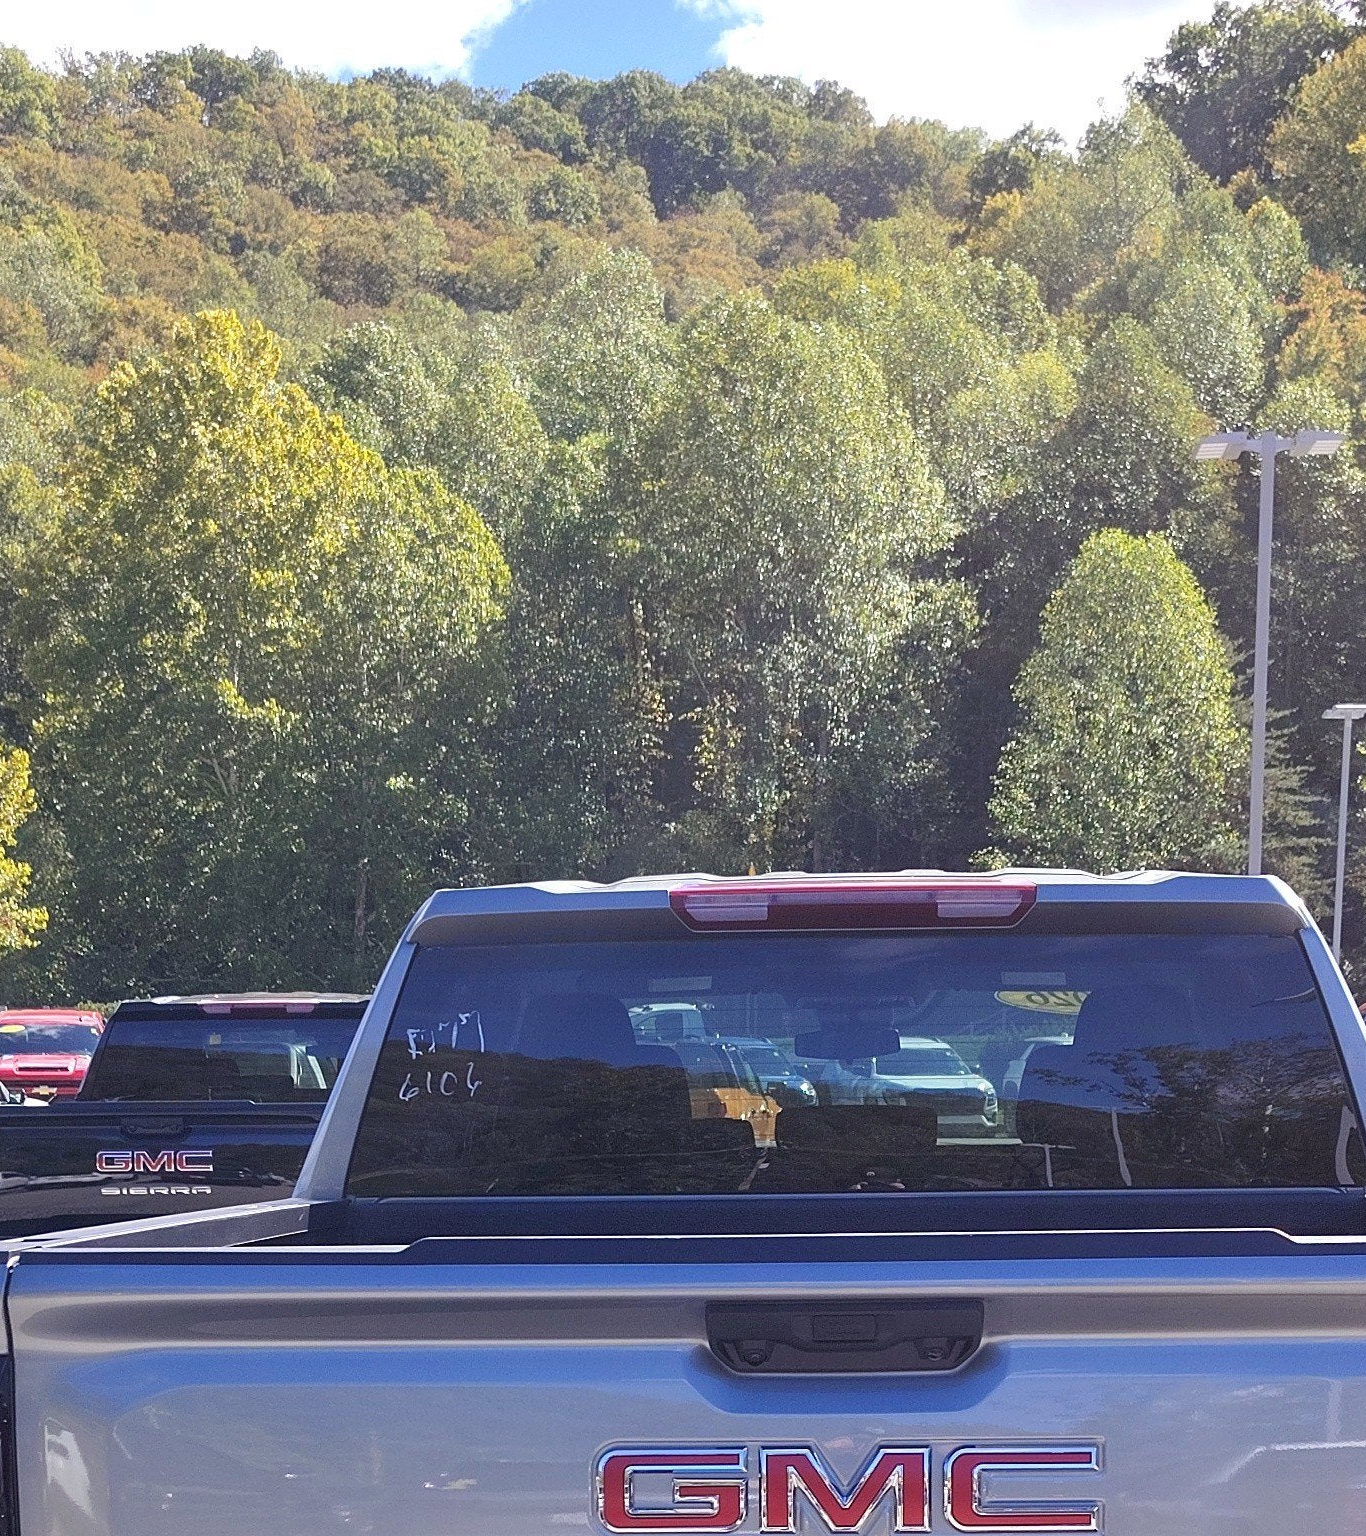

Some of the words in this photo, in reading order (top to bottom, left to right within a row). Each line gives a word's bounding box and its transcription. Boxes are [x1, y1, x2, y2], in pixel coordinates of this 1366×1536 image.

[96, 1150, 214, 1172] GMC
[101, 1186, 212, 1195] SIERRA
[593, 1442, 1101, 1536] GMC
